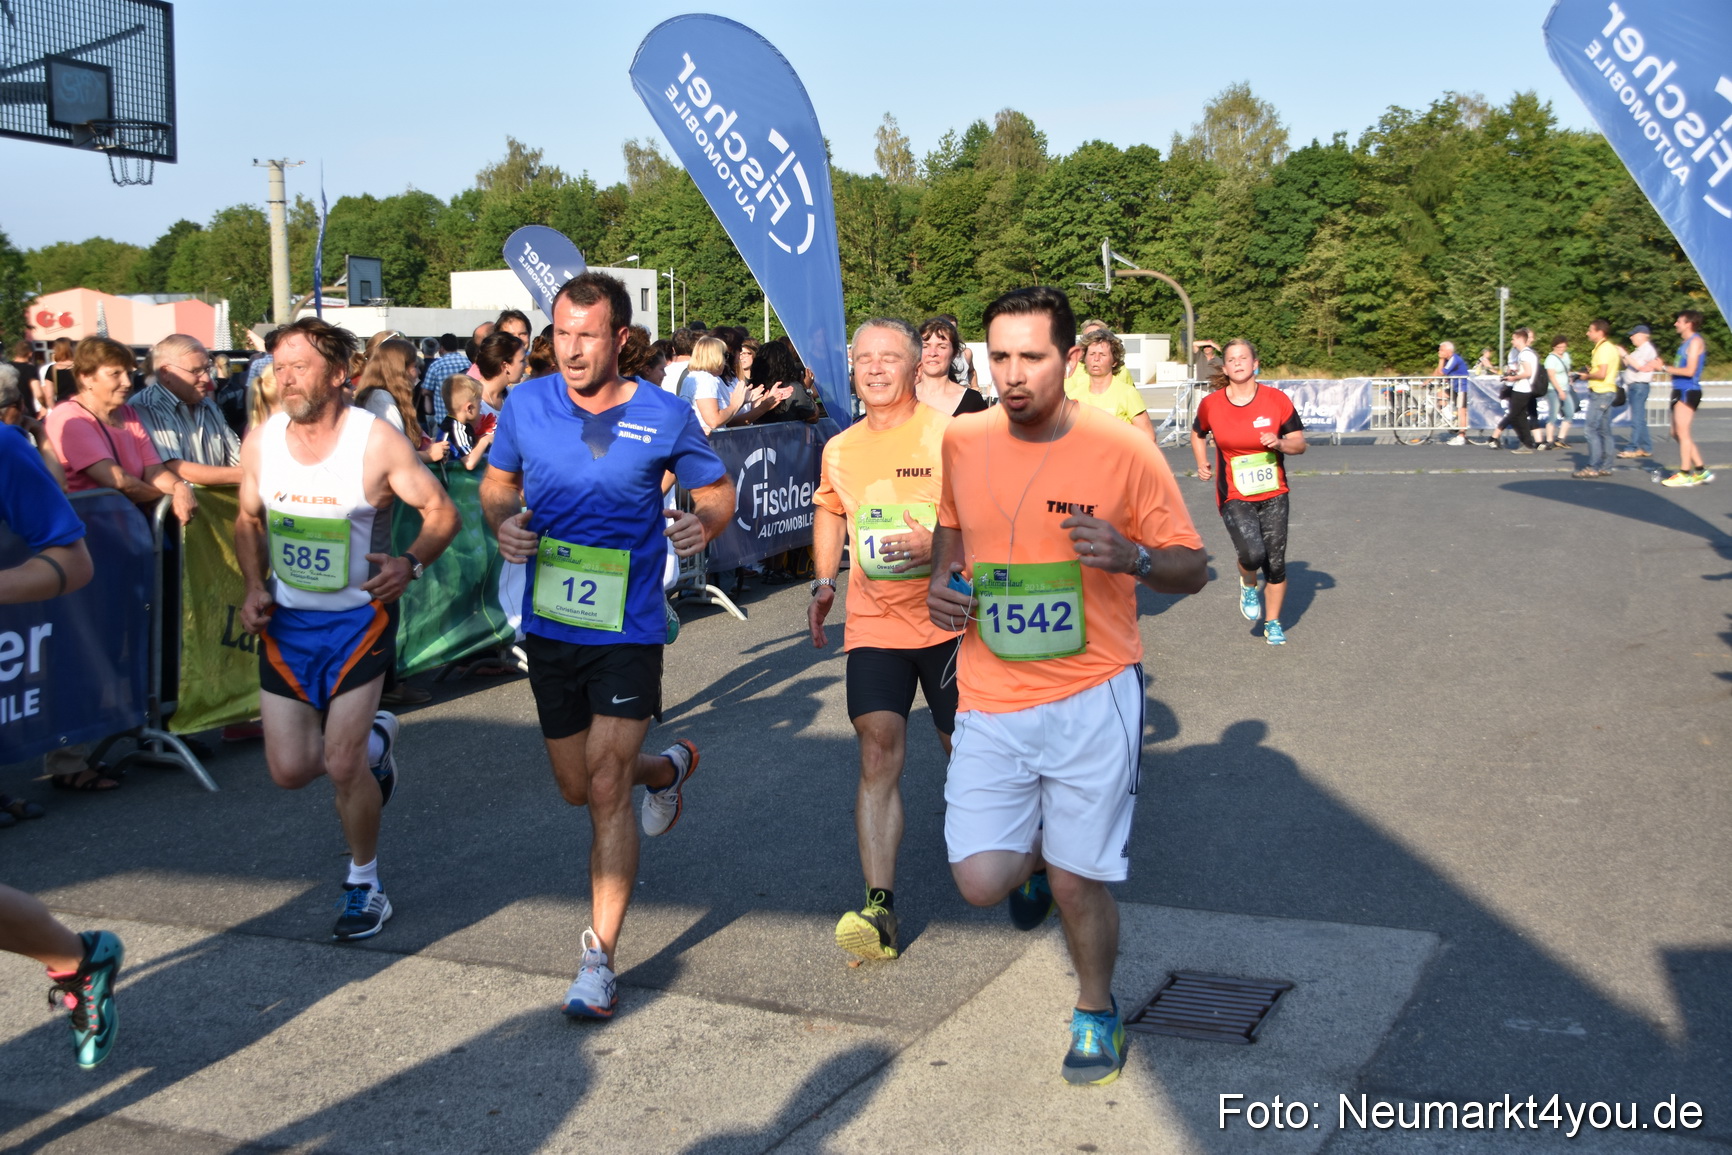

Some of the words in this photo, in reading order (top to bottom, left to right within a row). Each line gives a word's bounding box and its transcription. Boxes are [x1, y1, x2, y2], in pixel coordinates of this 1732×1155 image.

[618, 430, 642, 441] Allianz
[895, 467, 932, 477] THULE
[1239, 467, 1273, 485] 1168
[291, 494, 342, 506] KLEBL
[758, 511, 815, 539] AUTOMOBILE
[283, 543, 331, 572] 585
[562, 576, 597, 606] 12
[555, 605, 580, 615] Christian
[986, 601, 1073, 635] 1542
